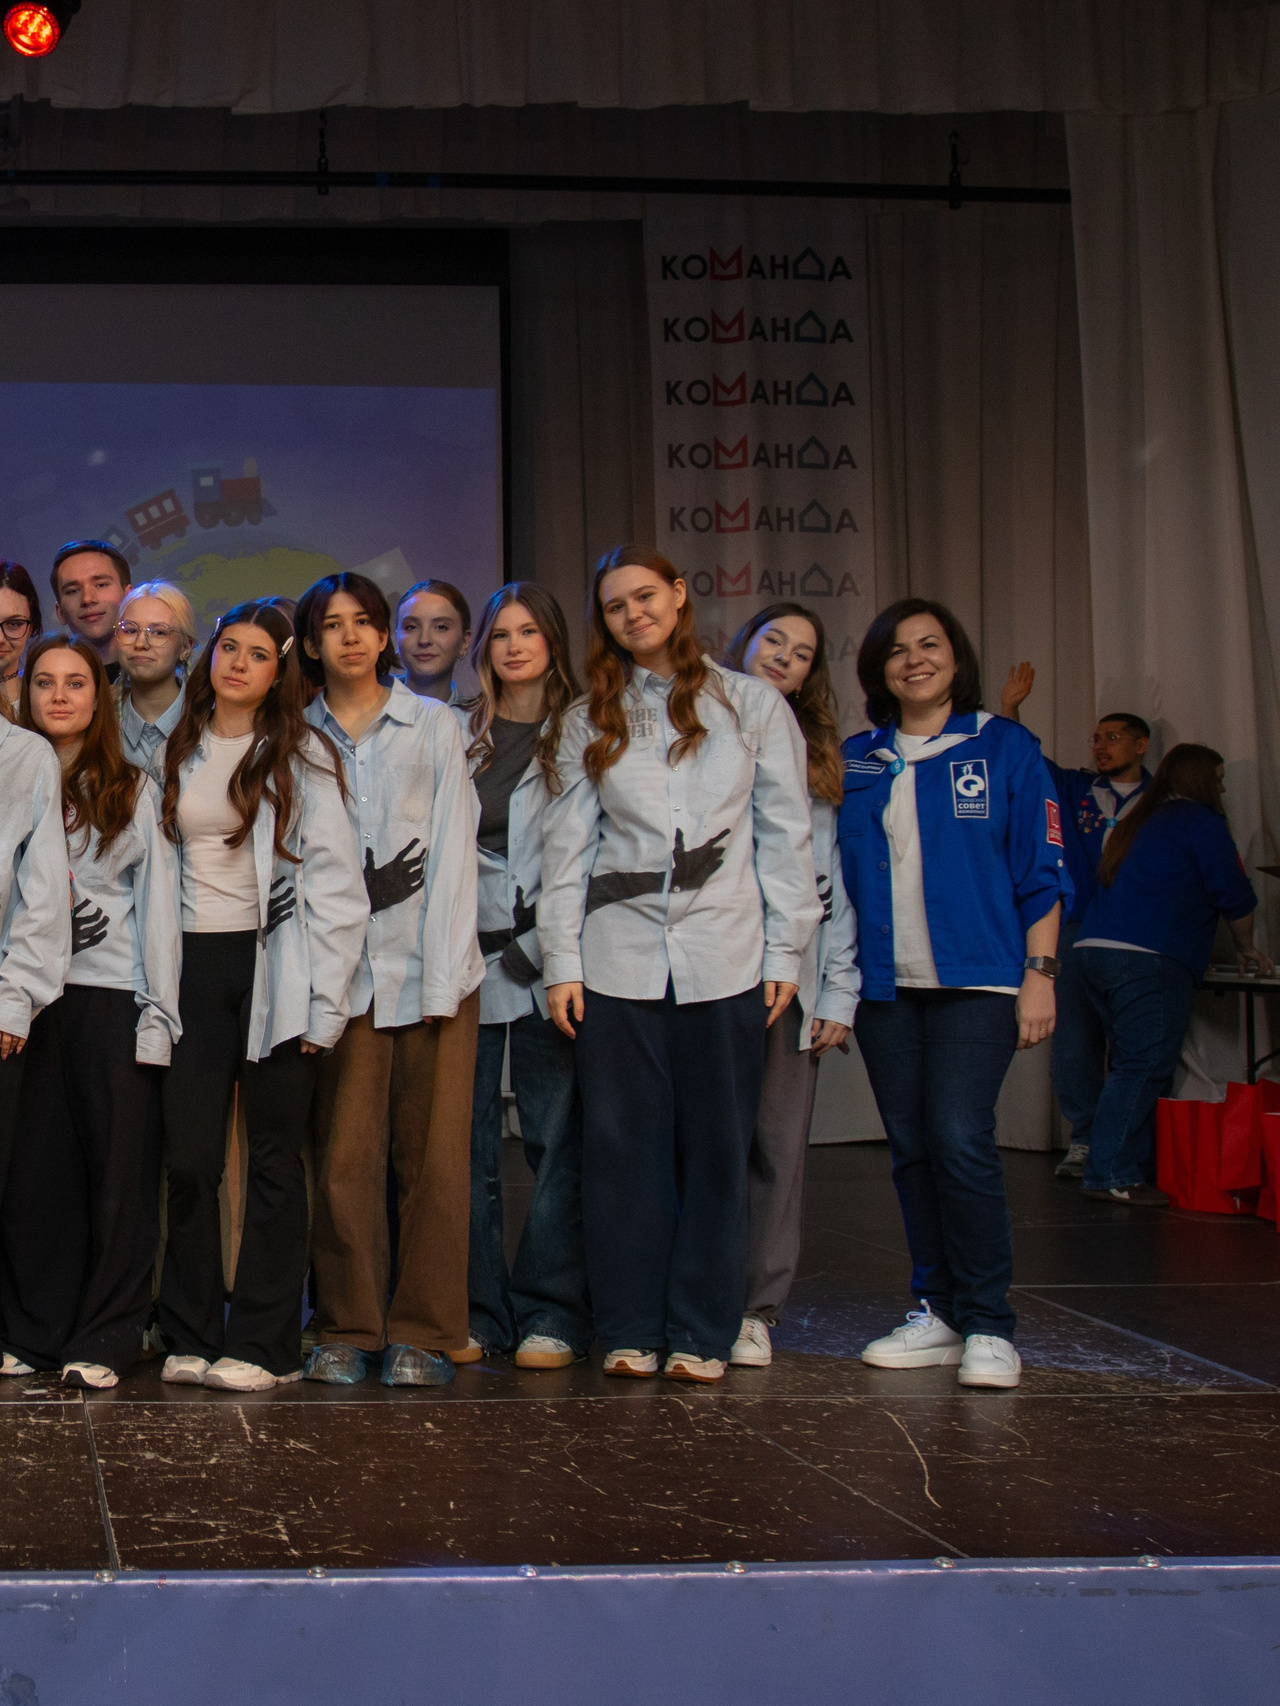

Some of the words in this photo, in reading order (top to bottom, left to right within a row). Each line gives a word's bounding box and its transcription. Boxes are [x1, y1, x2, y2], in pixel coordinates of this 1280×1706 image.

[661, 245, 852, 281] КОМАНДА
[663, 307, 854, 343] КОМАНДА
[666, 370, 855, 406] КОМАНДА
[667, 434, 857, 470] КОМАНДА
[669, 498, 858, 534] КОМАНДА
[682, 561, 860, 597] ОМАНДА
